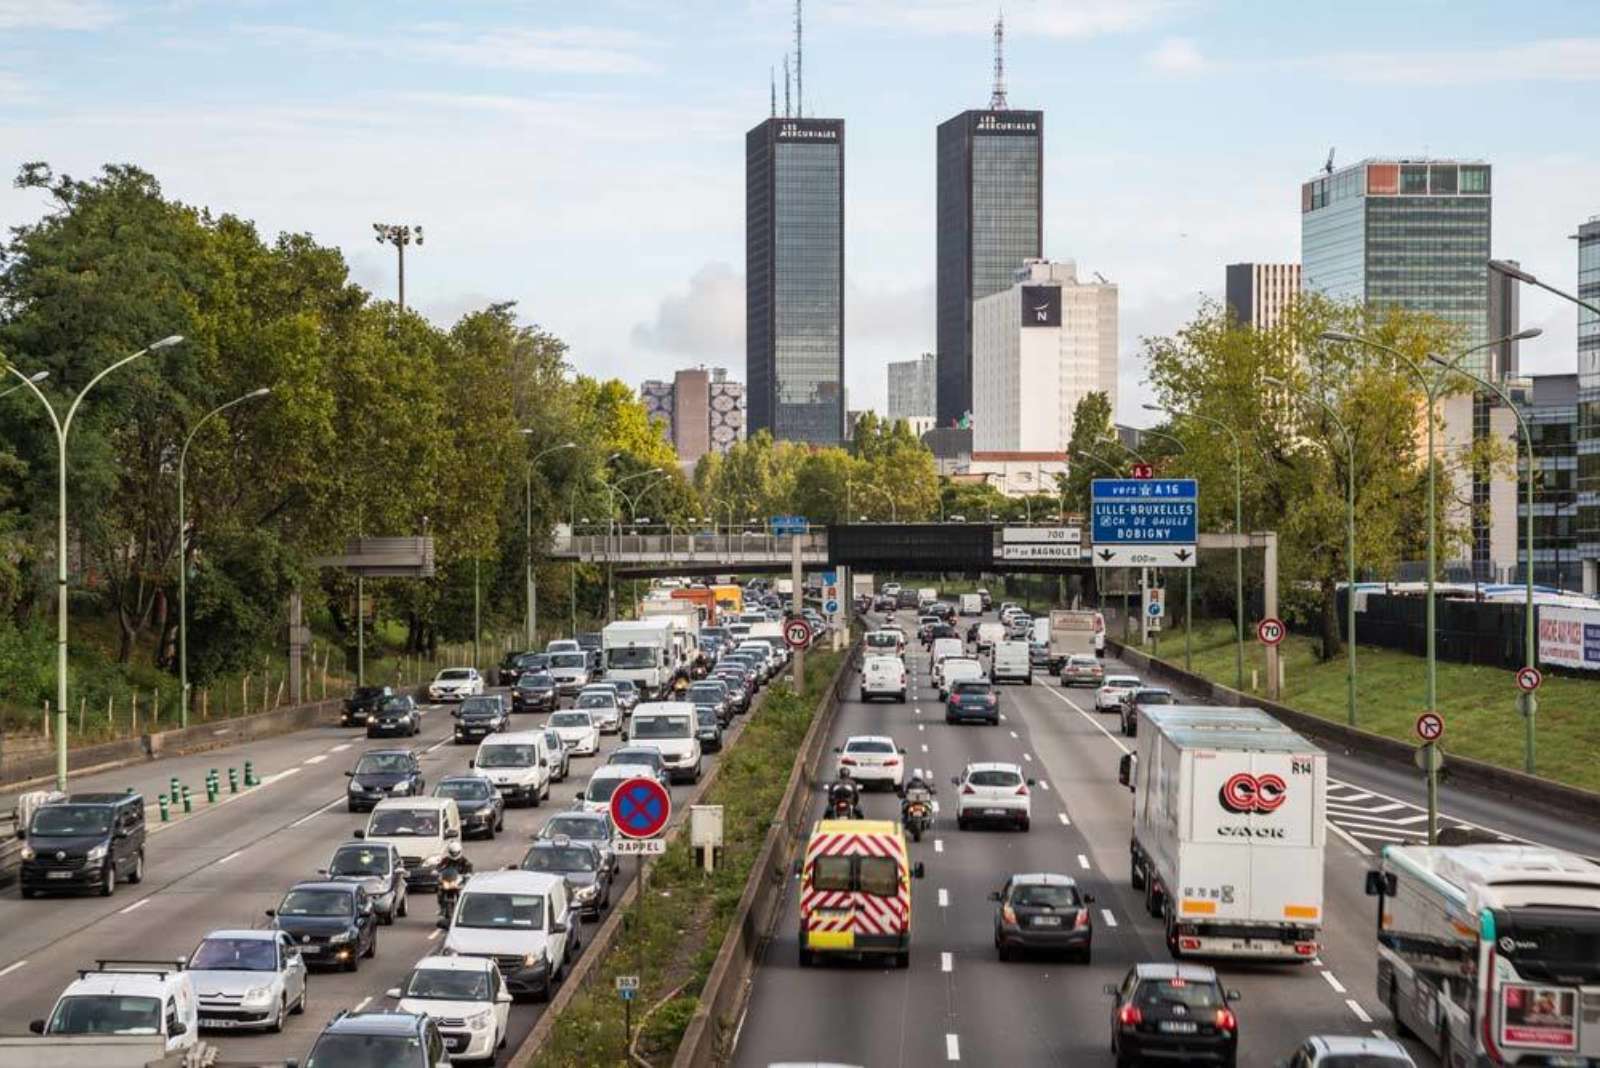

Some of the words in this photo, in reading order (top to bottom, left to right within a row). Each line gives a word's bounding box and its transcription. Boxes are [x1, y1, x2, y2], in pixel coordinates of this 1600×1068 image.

[1095, 503, 1193, 515] LILLE-BRUXELLES
[1133, 516, 1147, 526] DE
[1117, 528, 1171, 539] BOBIGNY
[1031, 547, 1078, 556] BAGNOLET
[790, 628, 806, 640] 70
[1264, 626, 1279, 637] 70
[1291, 761, 1311, 775] R14
[617, 842, 659, 851] RAPPEL
